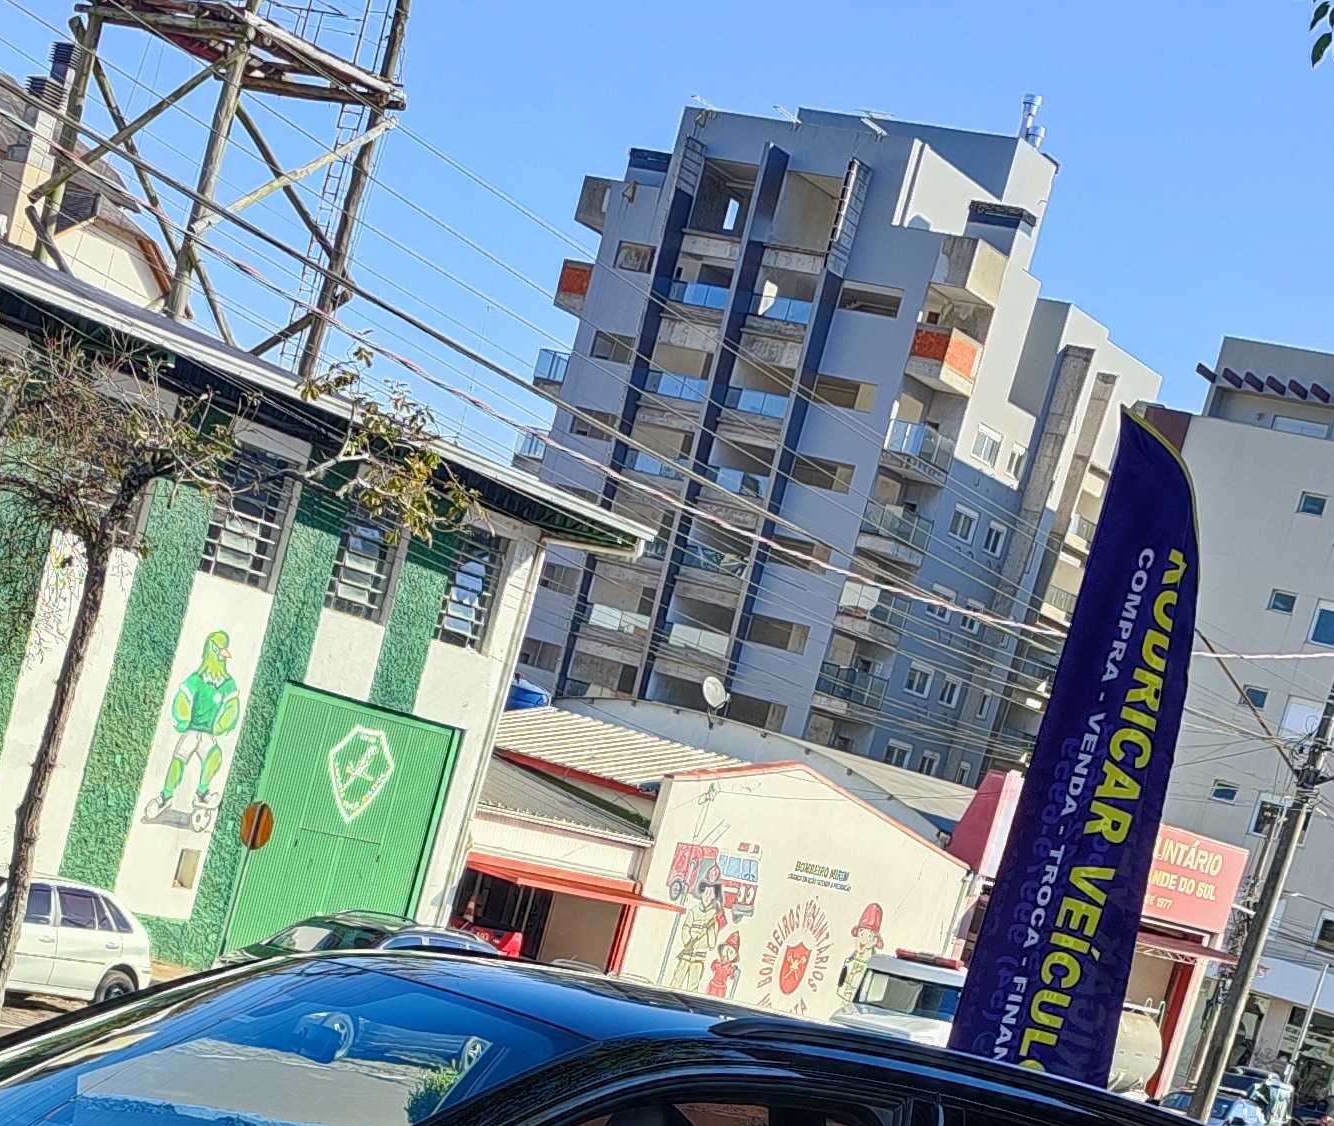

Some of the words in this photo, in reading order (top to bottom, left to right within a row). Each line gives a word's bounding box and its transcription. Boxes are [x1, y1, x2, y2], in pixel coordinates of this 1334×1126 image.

[1100, 548, 1155, 682] COMPRA
[1058, 712, 1107, 817] VENDA
[1023, 844, 1066, 949] TROCA
[1178, 875, 1196, 896] DO
[1195, 881, 1217, 901] SUL
[757, 903, 802, 989] BOMBEIROS
